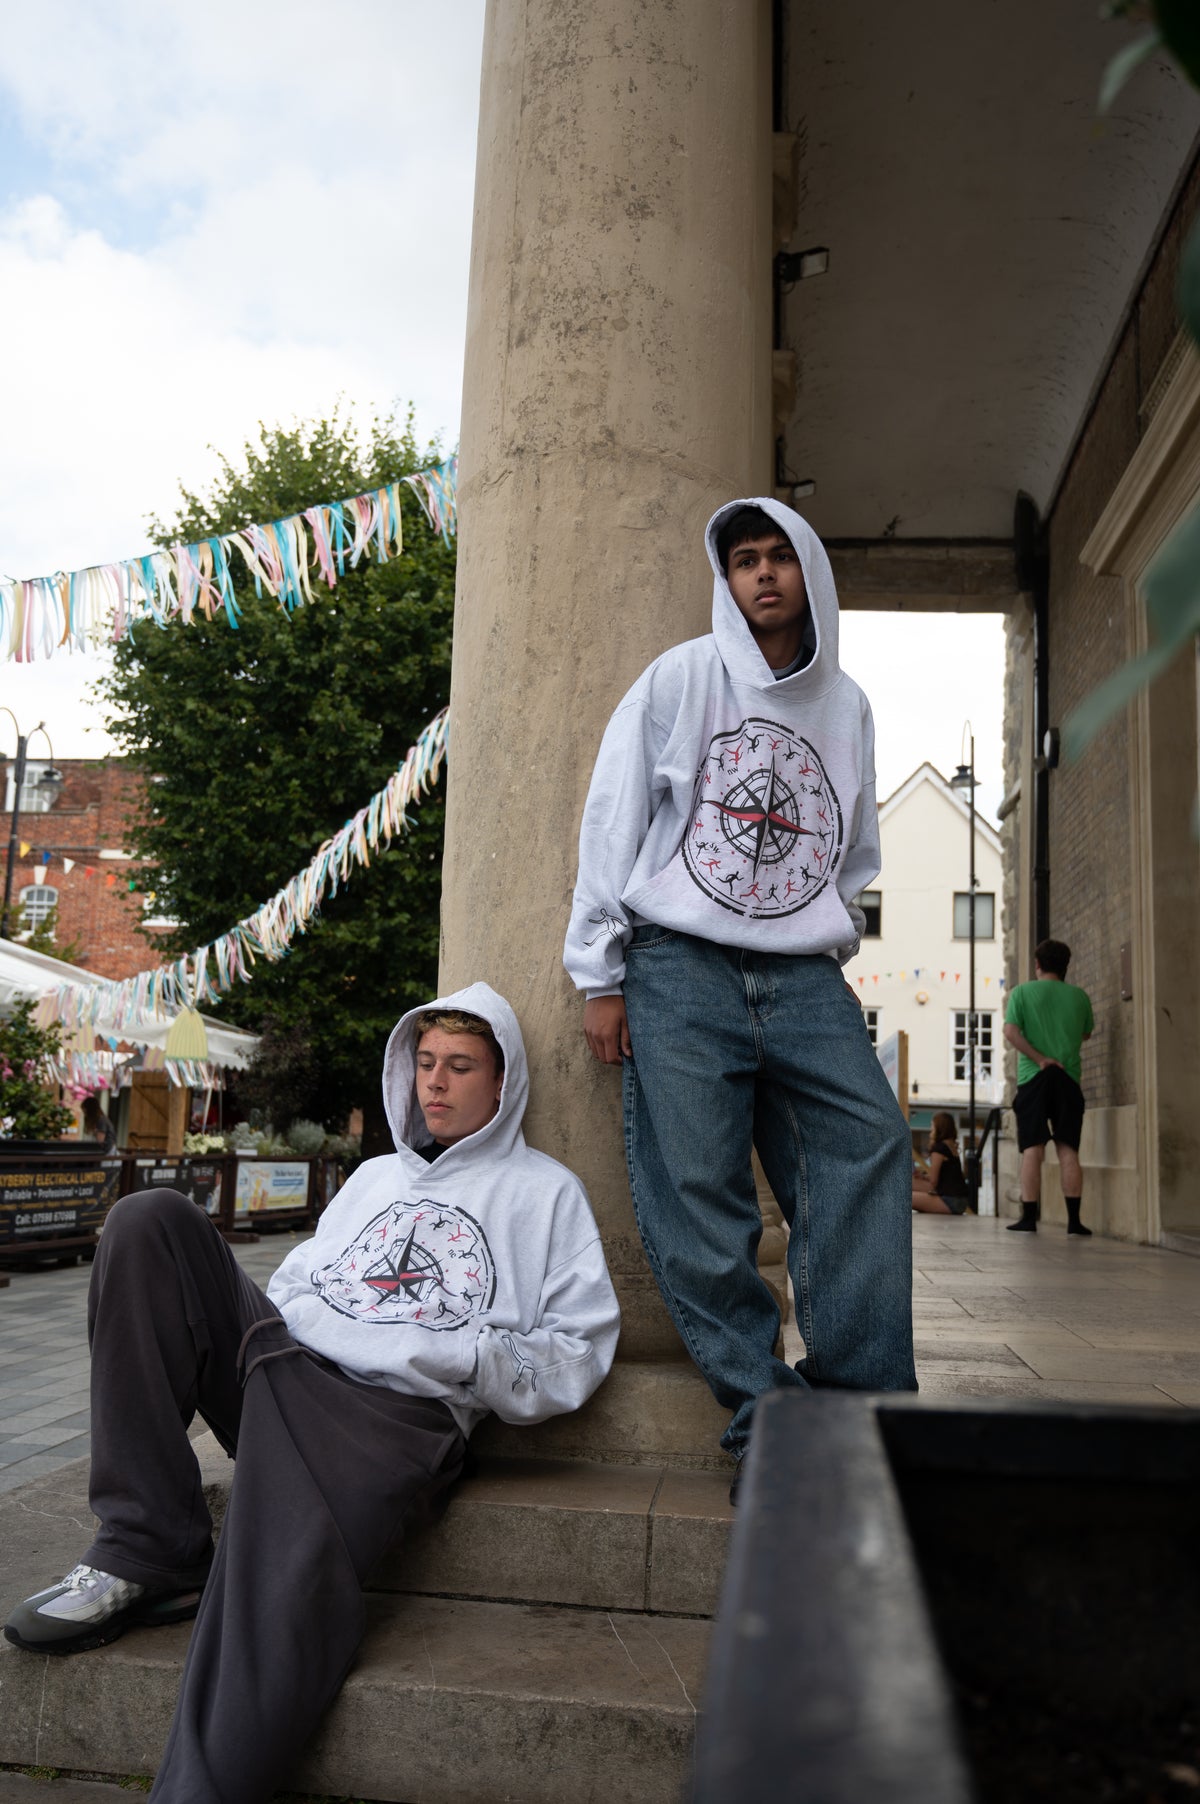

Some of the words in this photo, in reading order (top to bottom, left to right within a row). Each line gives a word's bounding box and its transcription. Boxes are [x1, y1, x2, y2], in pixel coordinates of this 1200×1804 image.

[727, 767, 739, 776] nw
[35, 1172, 79, 1186] ELECTRICAL
[80, 1171, 106, 1184] LIMITED
[4, 1189, 32, 1200] Reliable
[38, 1187, 74, 1198] Professional
[78, 1185, 94, 1197] Local
